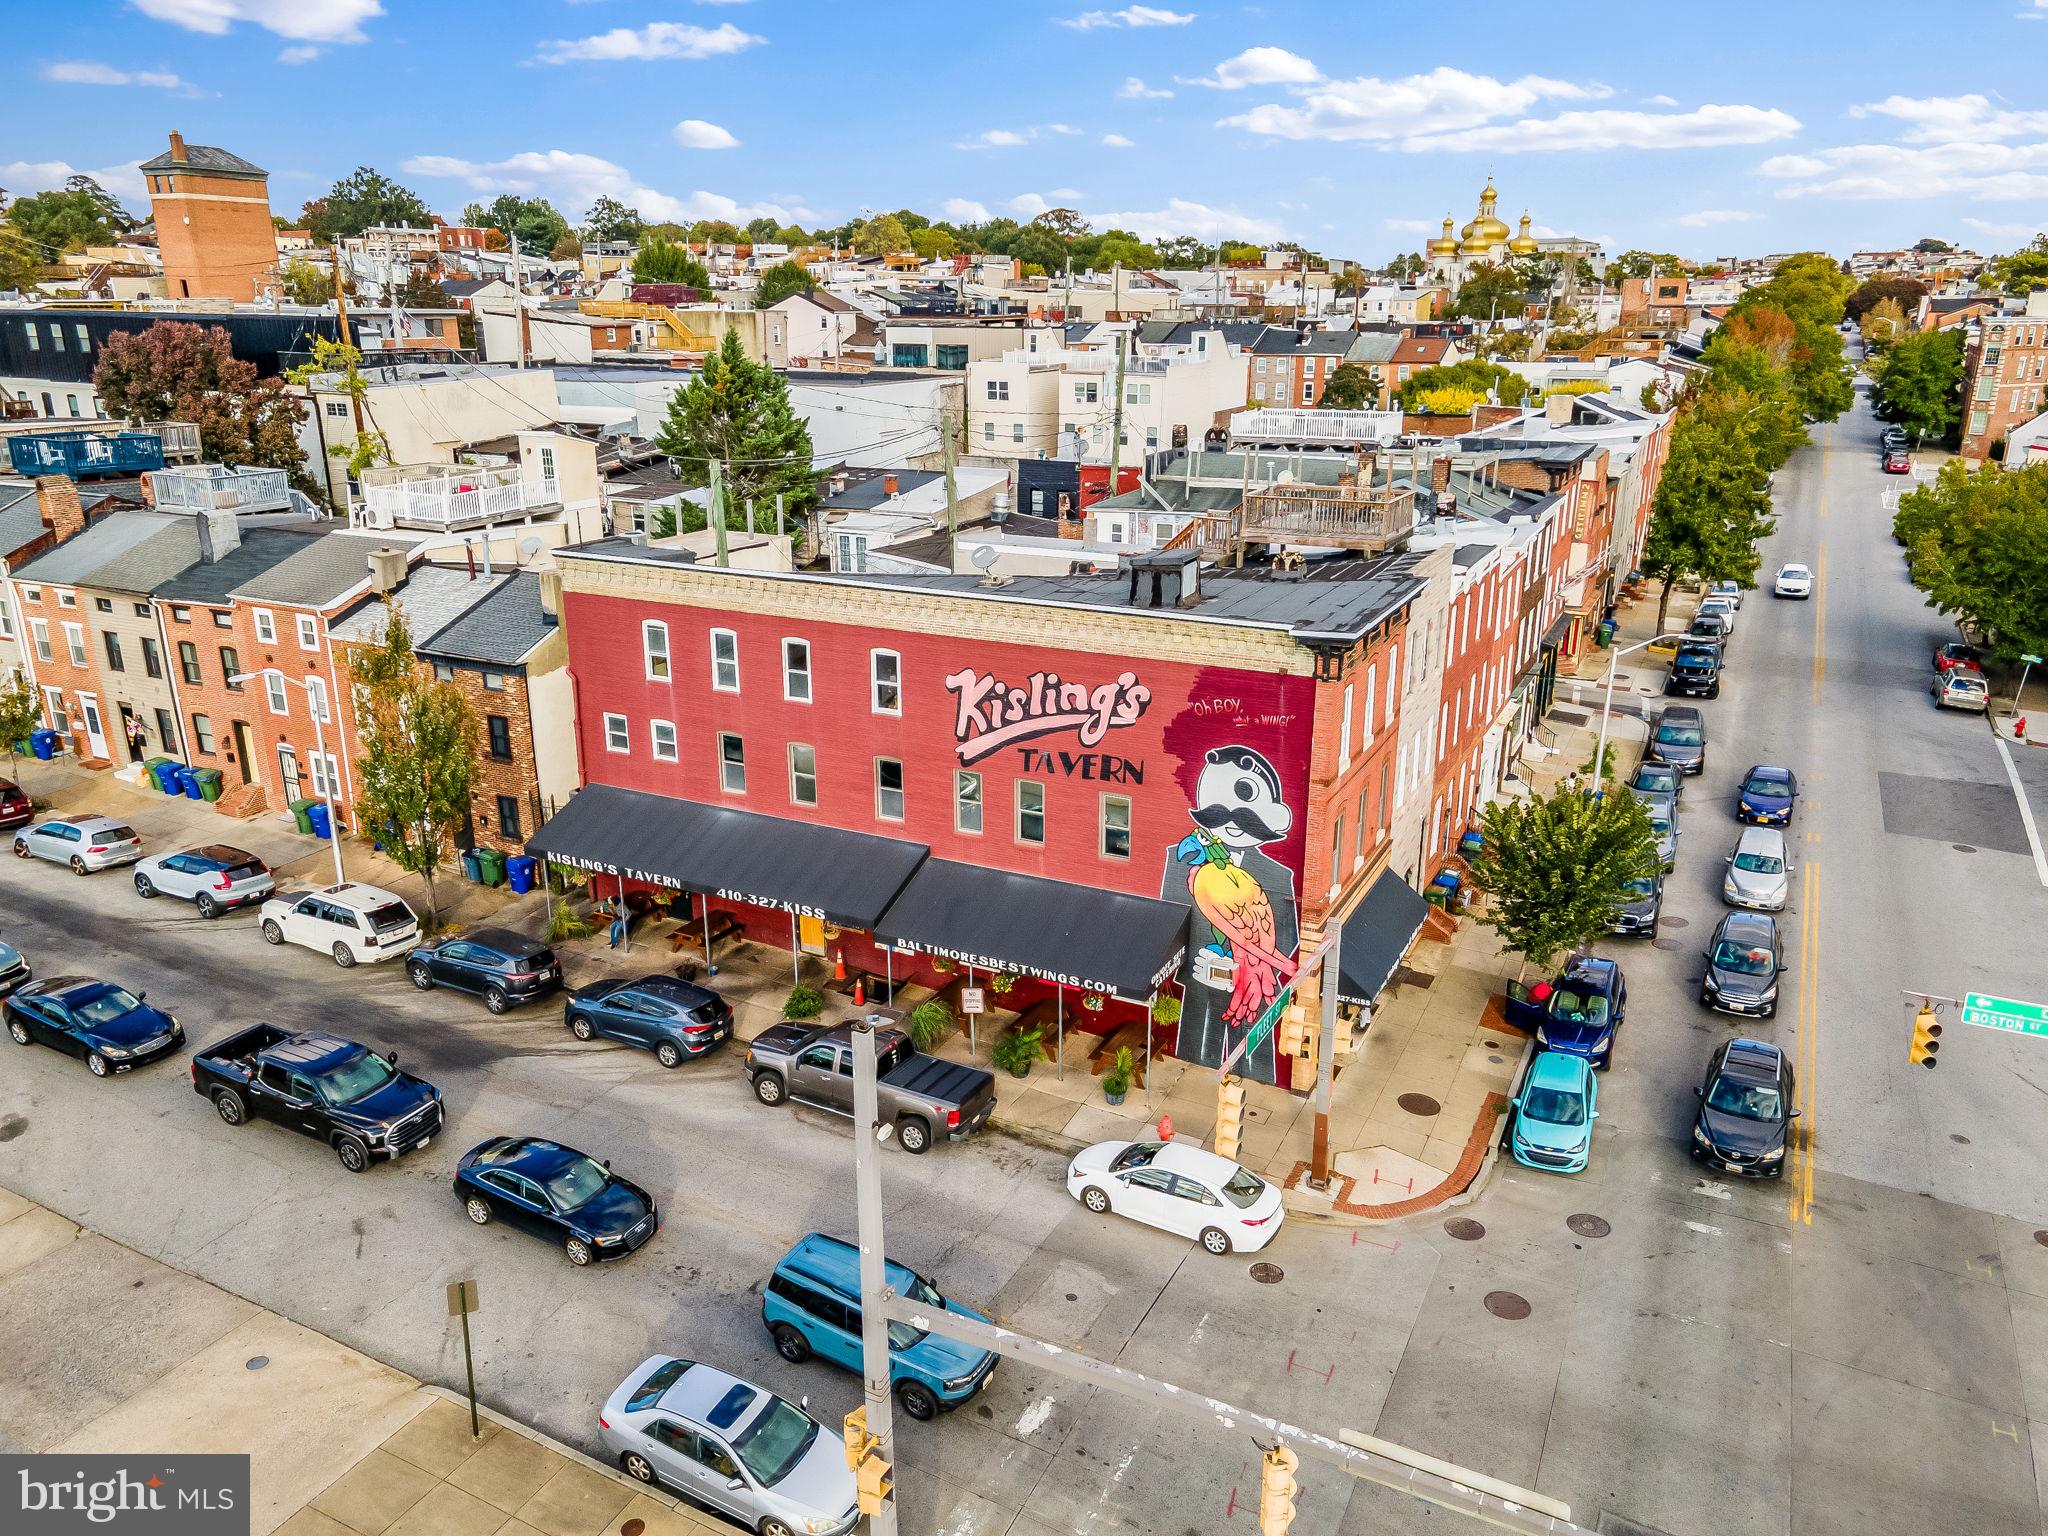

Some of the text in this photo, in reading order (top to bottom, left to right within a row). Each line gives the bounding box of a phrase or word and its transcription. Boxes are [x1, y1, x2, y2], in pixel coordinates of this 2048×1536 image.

[945, 667, 1152, 748] Kisling's
[1017, 748, 1145, 785] TAVERN
[547, 851, 681, 889] KISLING'S TAVERN
[716, 888, 826, 920] 410-327-KISS
[897, 938, 1118, 995] BALTIMORESBESTWINGS.COM
[1256, 1010, 1273, 1041] FLEET
[1971, 1011, 2025, 1031] BOSTON
[2029, 1021, 2043, 1032] ST
